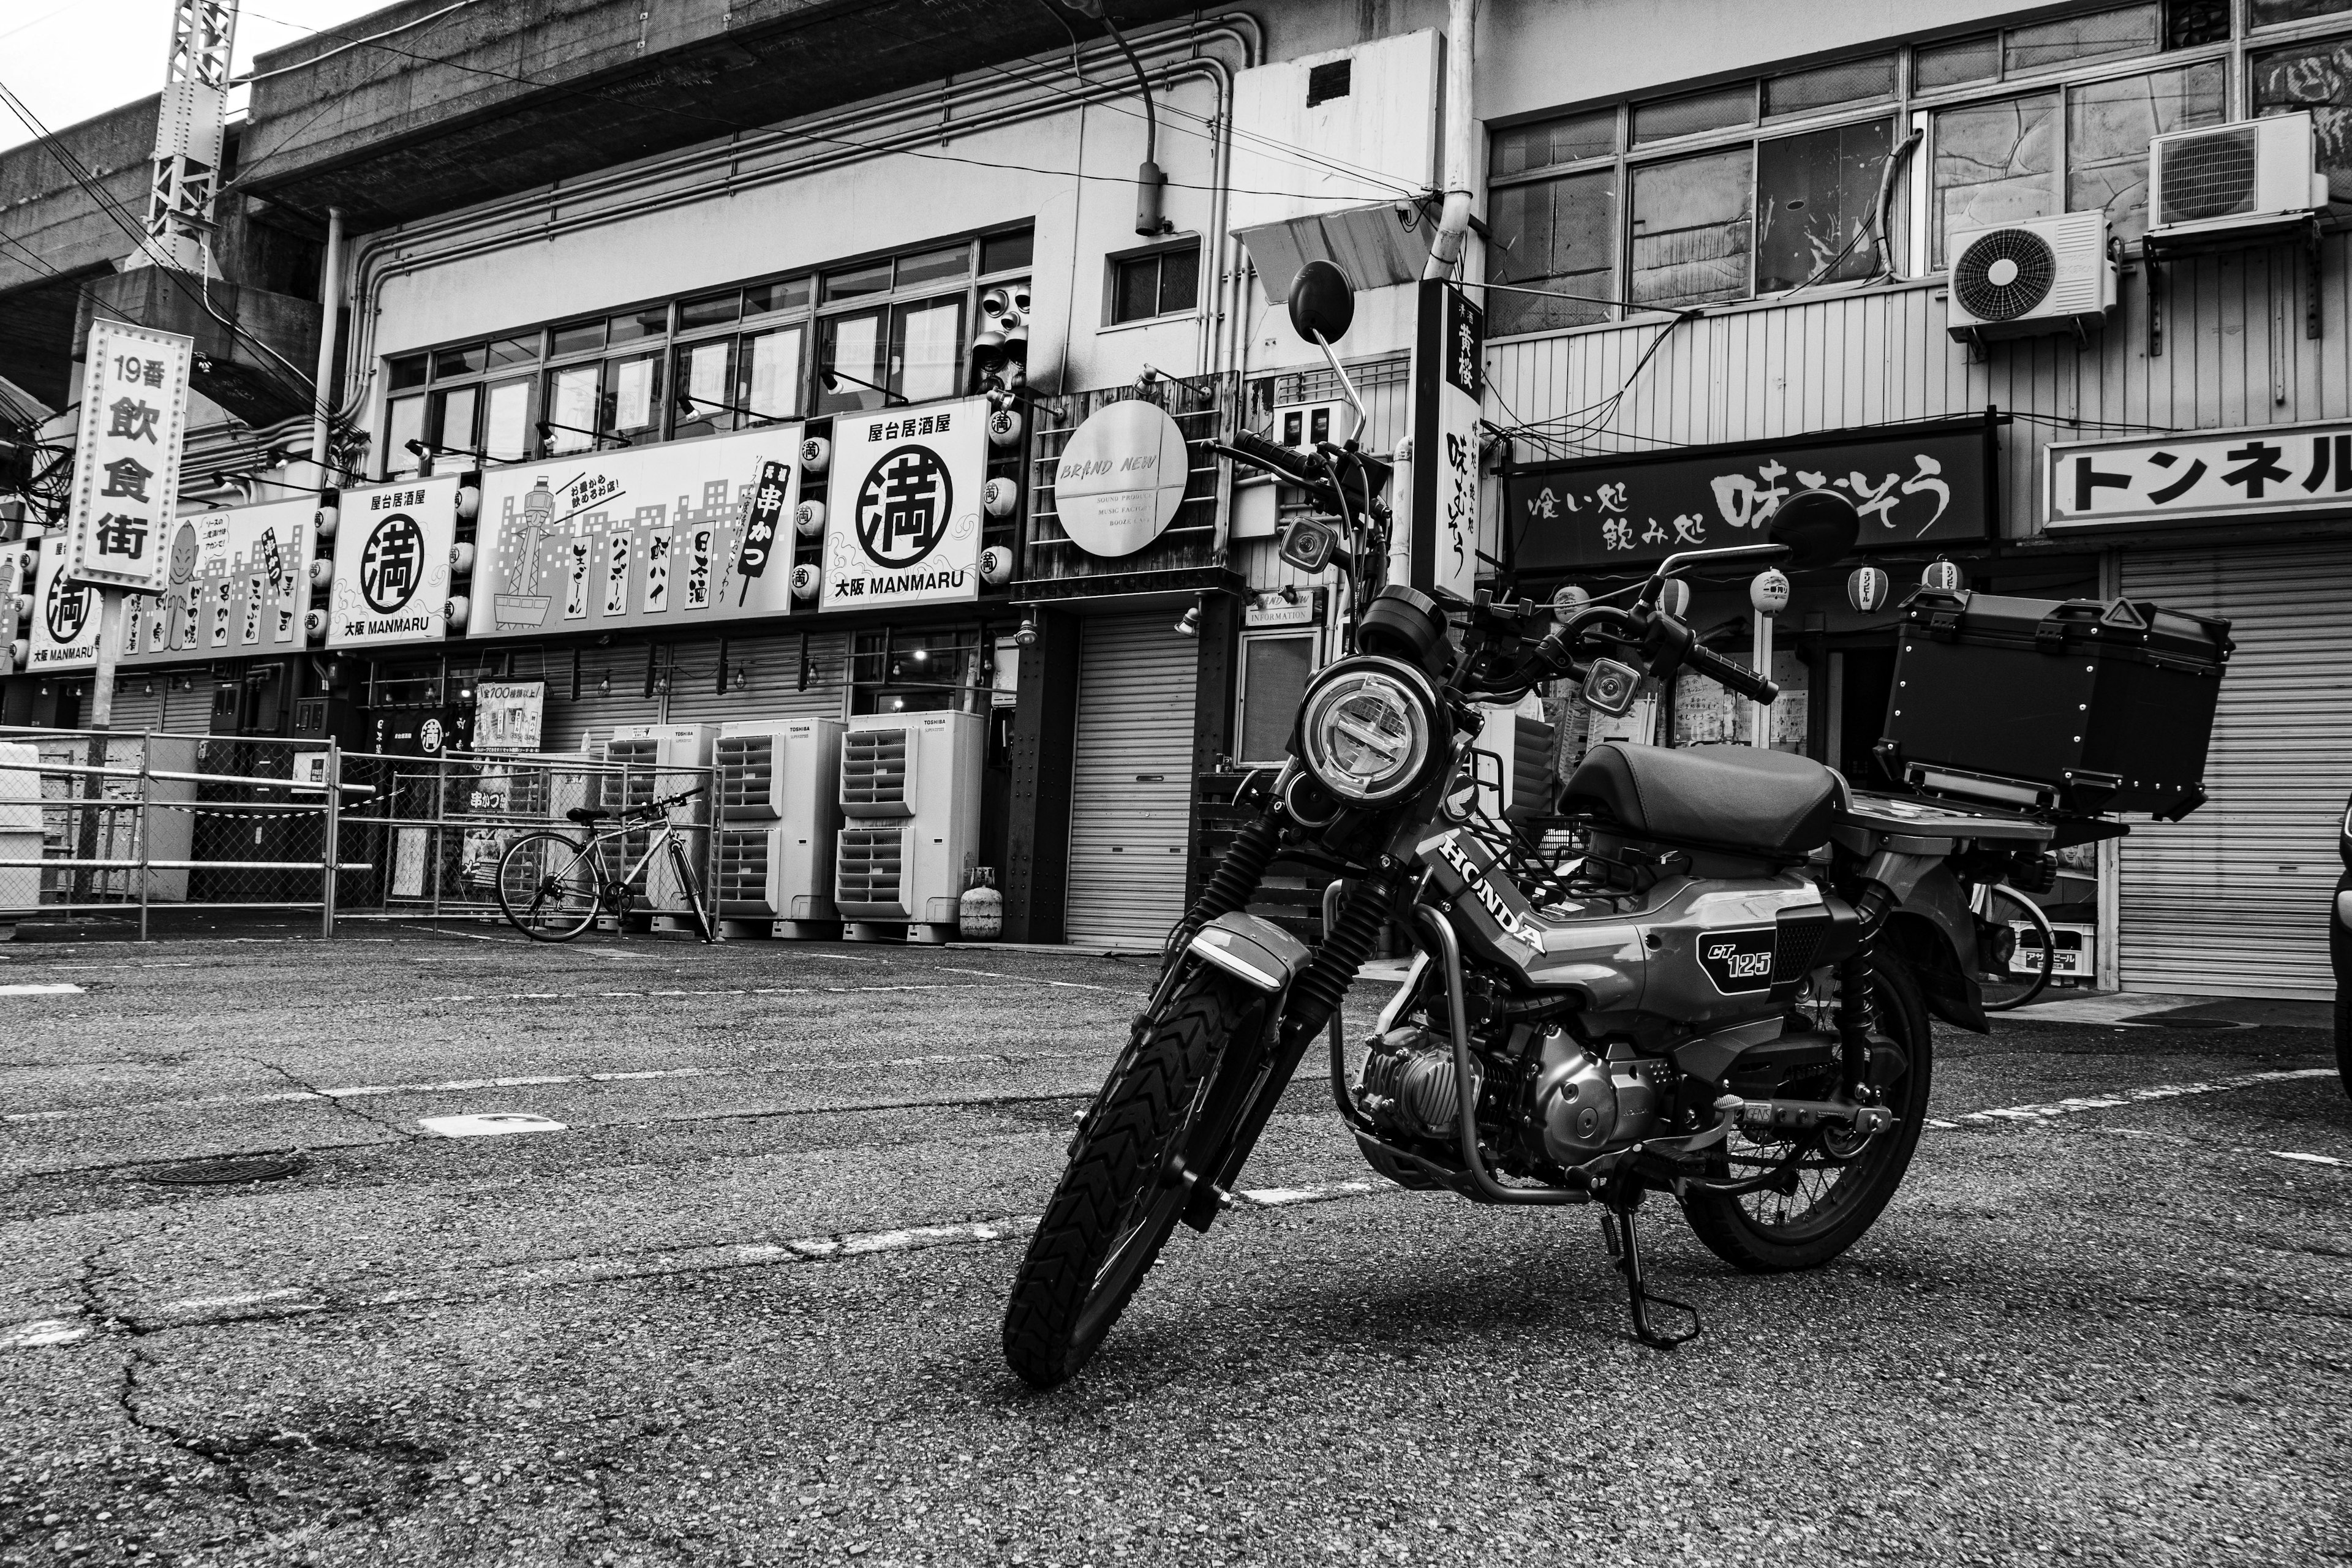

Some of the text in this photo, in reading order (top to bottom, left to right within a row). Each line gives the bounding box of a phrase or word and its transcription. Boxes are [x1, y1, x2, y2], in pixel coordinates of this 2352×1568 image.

[1459, 303, 1474, 325] 清酒
[1459, 323, 1474, 390] 黄桜
[114, 354, 165, 389] 19番
[868, 413, 951, 442] 屋台居酒屋
[992, 413, 1011, 434] 満
[802, 441, 819, 461] 満
[96, 396, 161, 560] 飲食街
[764, 465, 788, 482] 元祖
[1060, 454, 1157, 480] BRAND NEW
[2075, 434, 2352, 511] トンネル
[571, 474, 606, 497] お昼から
[983, 481, 998, 504] 満
[1121, 492, 1153, 501] PRODUCE
[1710, 454, 1950, 539] 味そう
[371, 489, 425, 511] 屋台居酒屋
[856, 445, 953, 569] 満
[1121, 505, 1152, 513] FACTORY
[1528, 481, 1629, 519] 喰い処
[744, 483, 782, 566] 串かつ
[796, 505, 812, 525] 満
[1602, 513, 1707, 551] 飲み処
[264, 538, 280, 579] 串かつ
[361, 513, 424, 614] 満
[650, 536, 671, 604] 酎ハイ
[689, 530, 710, 603] 日本酒
[980, 551, 997, 574] 満
[568, 544, 587, 614] 生ビール
[607, 537, 628, 611] ハイボール
[792, 568, 809, 588] 満
[835, 570, 965, 598] 大阪 MANMARU
[1863, 571, 1871, 603] キリンビール
[1763, 585, 1788, 594] 一番搾り
[215, 581, 230, 639] 串かつ
[246, 579, 261, 639] 天ぷら
[304, 612, 318, 630] 満
[1251, 611, 1306, 622] INFORMATION
[344, 616, 429, 636] 大阪 MANMARU
[34, 646, 93, 662] 大阪 MANMARU
[483, 687, 535, 698] 全100種類以上
[421, 718, 443, 753] 満
[470, 791, 500, 808] 串かつ
[1439, 834, 1547, 956] HONDA
[1708, 944, 1736, 959] CT
[2027, 952, 2075, 963] アサビール
[1728, 952, 1771, 978] 125
